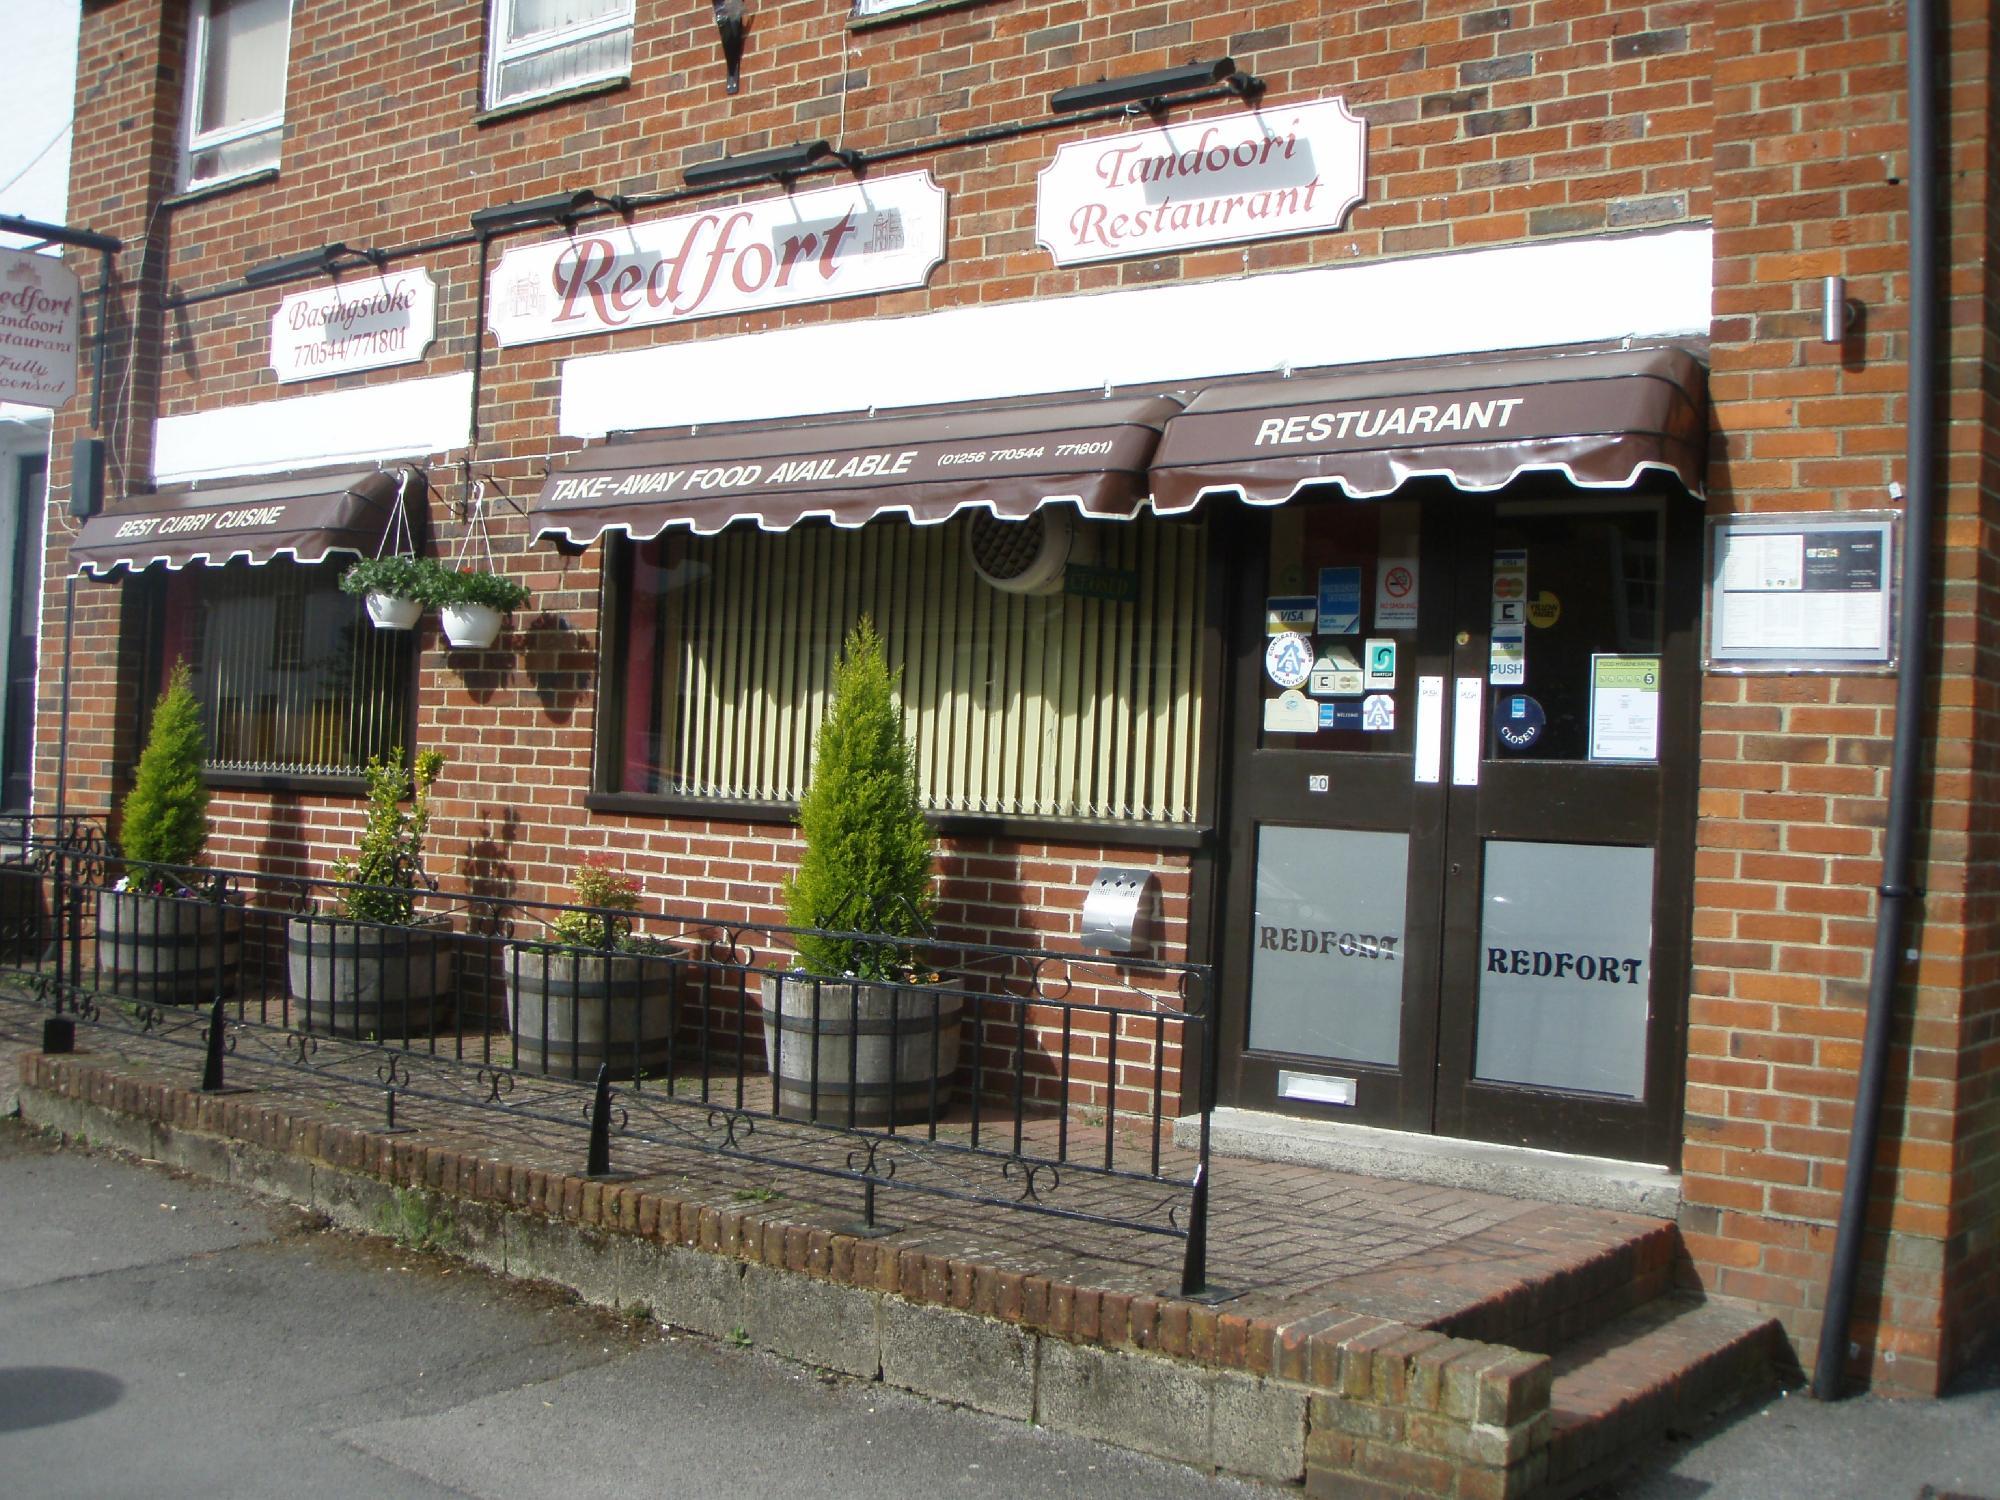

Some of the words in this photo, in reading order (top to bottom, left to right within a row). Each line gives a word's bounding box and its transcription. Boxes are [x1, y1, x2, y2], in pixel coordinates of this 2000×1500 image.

[1096, 118, 1300, 188] Tandoori
[1070, 174, 1324, 248] Restaurant
[551, 202, 856, 326] Redfort
[0, 286, 73, 317] edfort
[288, 278, 416, 331] Basingstoke
[0, 312, 64, 335] andoori
[0, 332, 71, 353] staurant
[294, 327, 406, 368] 770544/771801
[0, 378, 66, 393] censed
[1254, 399, 1523, 446] RESTUARANT
[937, 451, 986, 467] (01256
[989, 446, 1044, 462] 770544
[1055, 440, 1112, 456] 771801)
[551, 470, 686, 501] TAKE-AWAY
[683, 465, 763, 490] FOOD
[765, 451, 918, 484] AVAILABLE
[115, 518, 162, 538] BEST
[158, 512, 217, 534] CURRY
[214, 506, 286, 530] CUISINE
[1280, 610, 1304, 622] VISA
[1271, 670, 1305, 685] APPROVED
[1491, 664, 1523, 675] PUSH
[1645, 674, 1653, 684] 5
[1501, 726, 1535, 744] CLOSED
[1260, 926, 1399, 960] REDFORT
[1487, 947, 1642, 985] REDFORT
